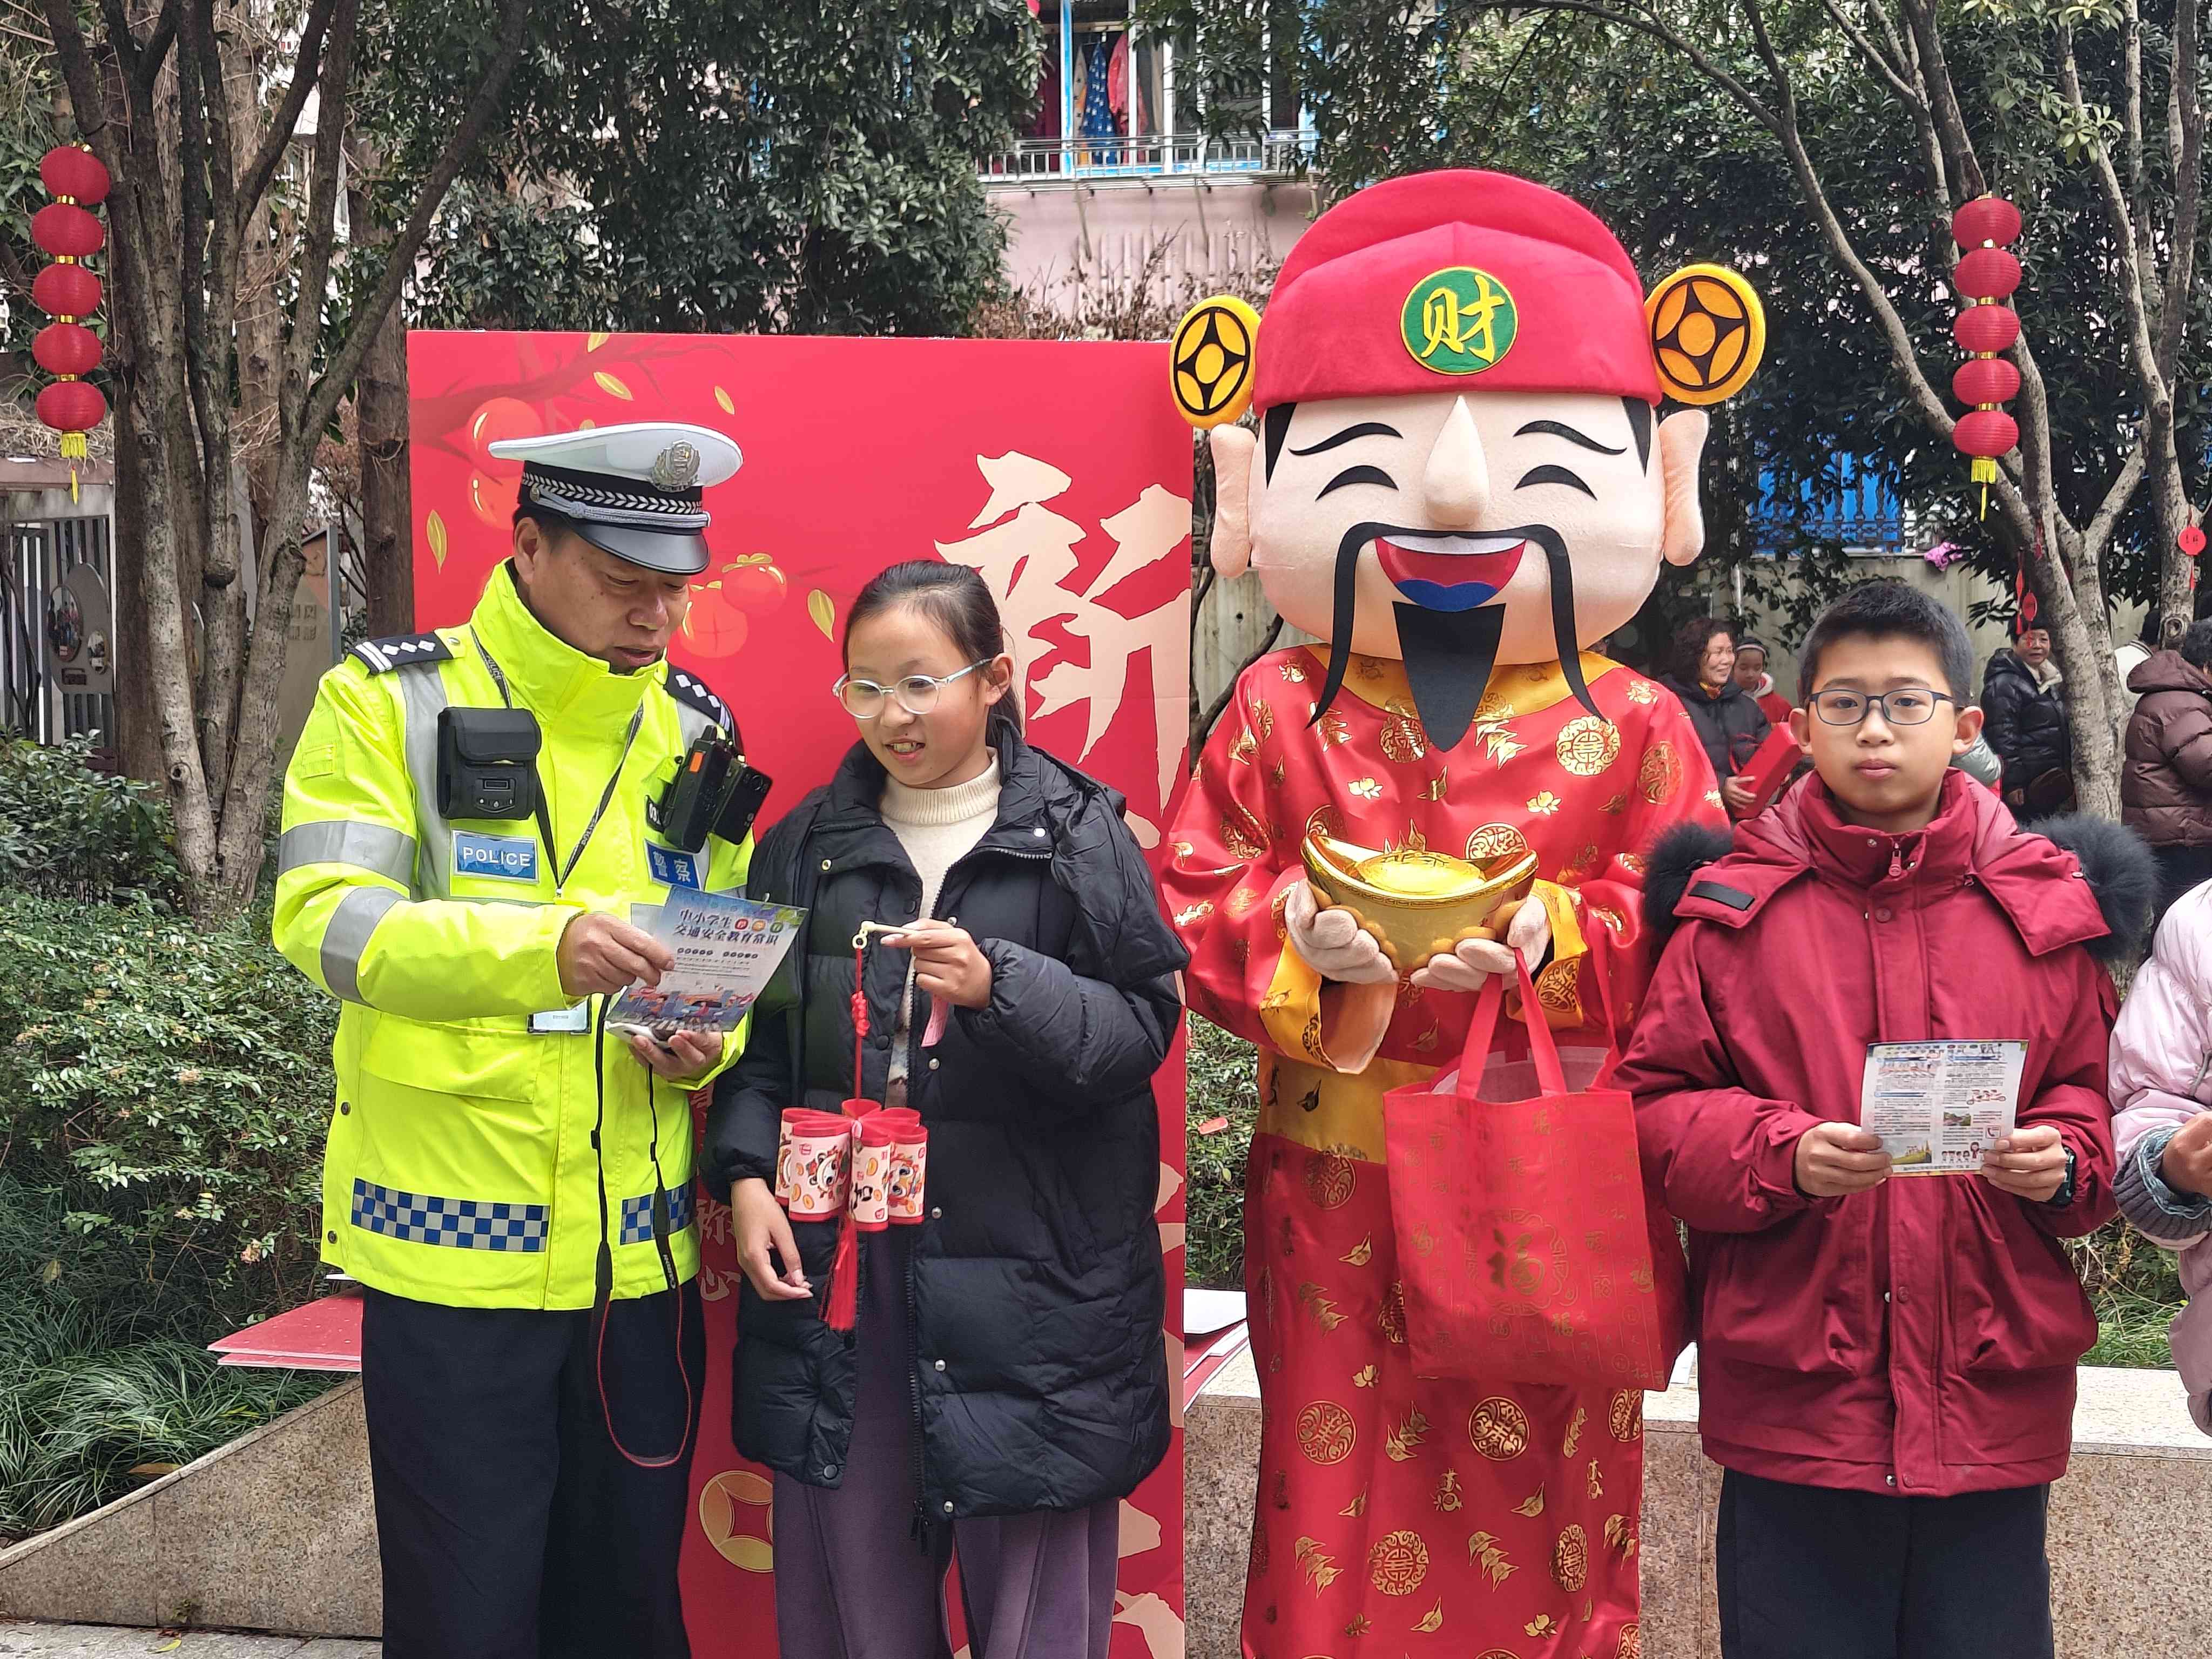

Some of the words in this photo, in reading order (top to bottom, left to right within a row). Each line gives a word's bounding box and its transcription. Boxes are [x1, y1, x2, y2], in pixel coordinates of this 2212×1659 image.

[1420, 274, 1506, 365] 财
[934, 449, 1193, 817] 新
[463, 846, 531, 867] POLICE
[653, 851, 691, 883] 警察
[672, 922, 780, 946] 交通安全教育常识
[679, 908, 733, 928] 中小学生
[1487, 1228, 1545, 1295] 福
